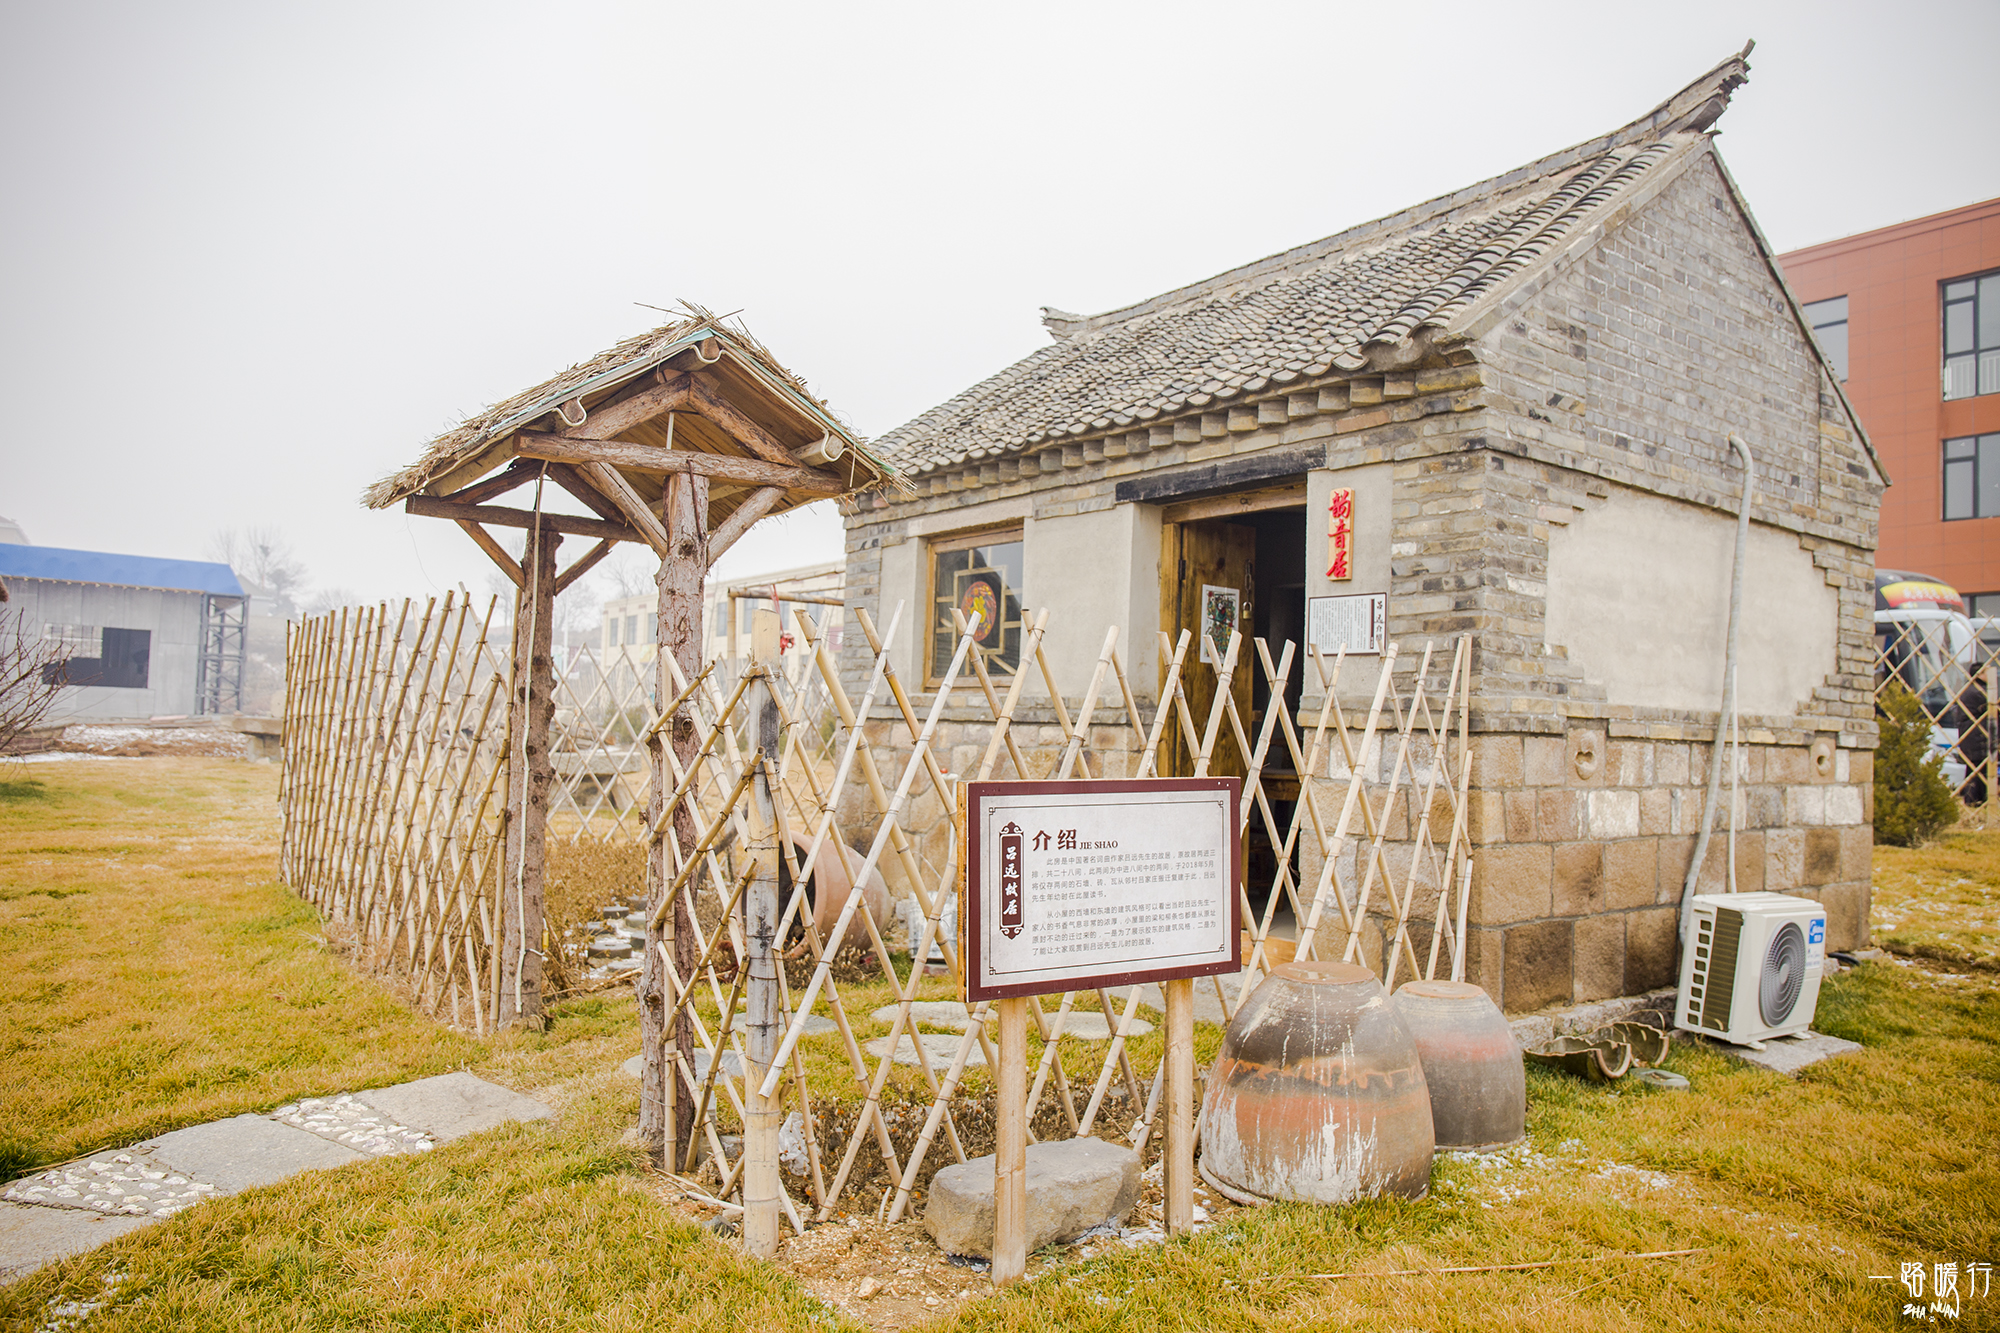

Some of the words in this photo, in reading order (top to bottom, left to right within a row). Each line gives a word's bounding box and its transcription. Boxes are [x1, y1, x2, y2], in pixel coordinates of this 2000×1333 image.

[1032, 829, 1077, 851] 介绍
[1079, 841, 1092, 850] JIE
[1094, 840, 1119, 849] SHAO
[1003, 846, 1020, 915] 吕远故居
